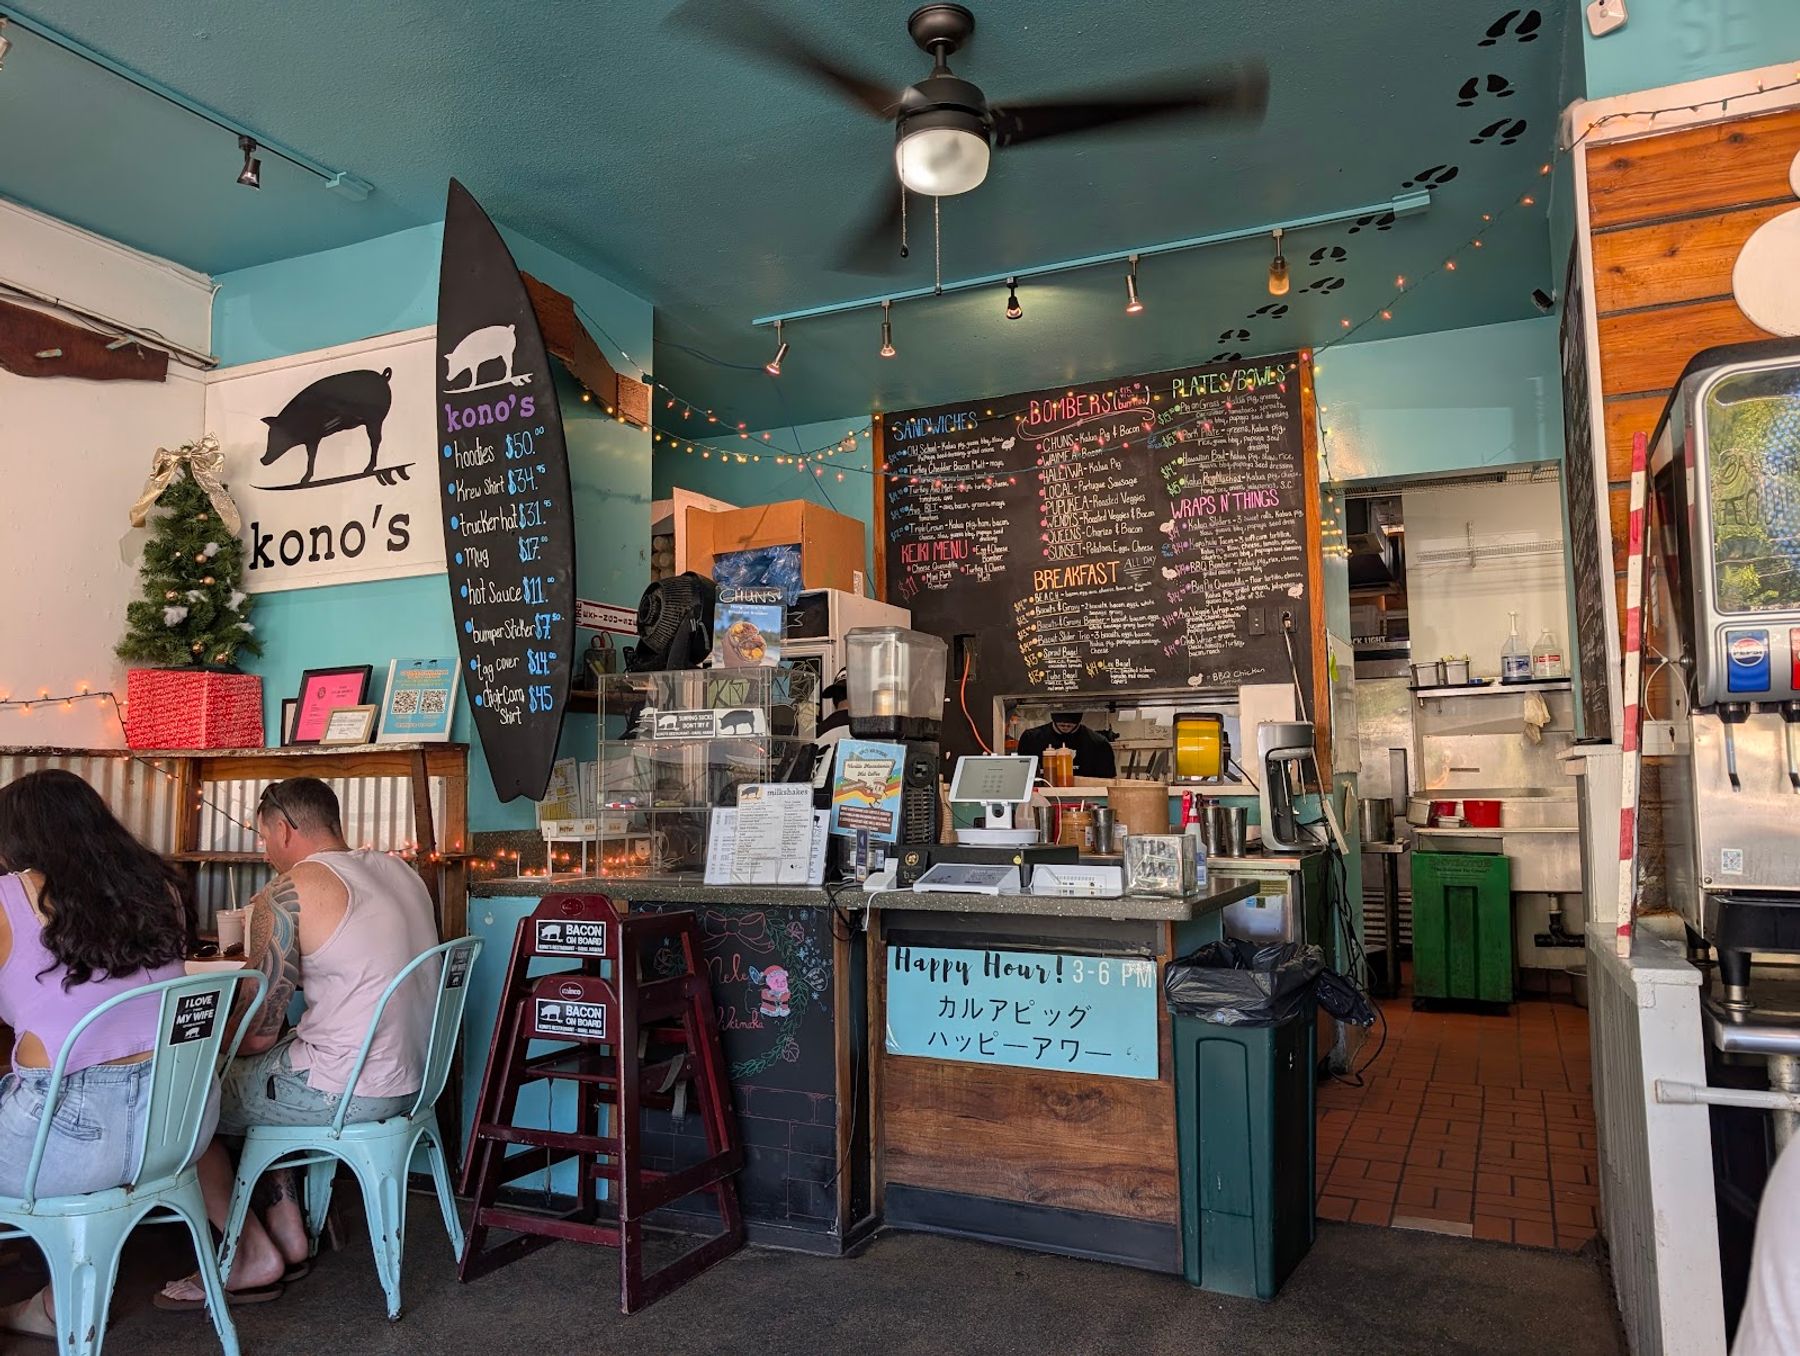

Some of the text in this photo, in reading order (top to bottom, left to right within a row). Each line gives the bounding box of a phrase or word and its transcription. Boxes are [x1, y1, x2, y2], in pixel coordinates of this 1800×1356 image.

[1172, 364, 1285, 398] PLATES/BOWLS
[445, 394, 535, 432] kono's
[1030, 393, 1111, 425] BOMBERS
[894, 411, 978, 440] SANDWICHES
[1042, 434, 1074, 452] CHUNS
[1120, 426, 1140, 436] Bacon
[454, 438, 495, 468] hoodies
[456, 480, 481, 502] Krew
[484, 475, 504, 496] Shirt
[1044, 483, 1073, 500] LOCAL
[1171, 496, 1216, 519] WRAPS
[1232, 488, 1280, 511] THINGS
[249, 504, 410, 570] kono's
[1121, 522, 1143, 534] Bacon
[902, 540, 968, 563] KEIKI MENU
[1048, 542, 1082, 560] SUNSET
[1034, 561, 1120, 591] BREAKFAST
[1124, 558, 1140, 568] ALL
[1143, 555, 1156, 566] DAY
[467, 578, 486, 606] hot
[489, 582, 522, 604] Sauce
[476, 654, 495, 682] tag
[496, 656, 520, 672] cover
[528, 684, 553, 714] $45
[500, 706, 522, 725] Shirt
[767, 788, 808, 796] milkshakes
[566, 924, 602, 936] BACON
[894, 947, 973, 986] Happy
[984, 951, 1063, 984] Hour!
[185, 995, 213, 1008] I LOVE
[566, 1005, 602, 1018] BACON
[938, 995, 1092, 1028] カルアピッグ
[176, 1009, 214, 1024] MY WIFE
[578, 1019, 602, 1028] BOARD
[928, 1030, 1112, 1062] ハッピーアワー
